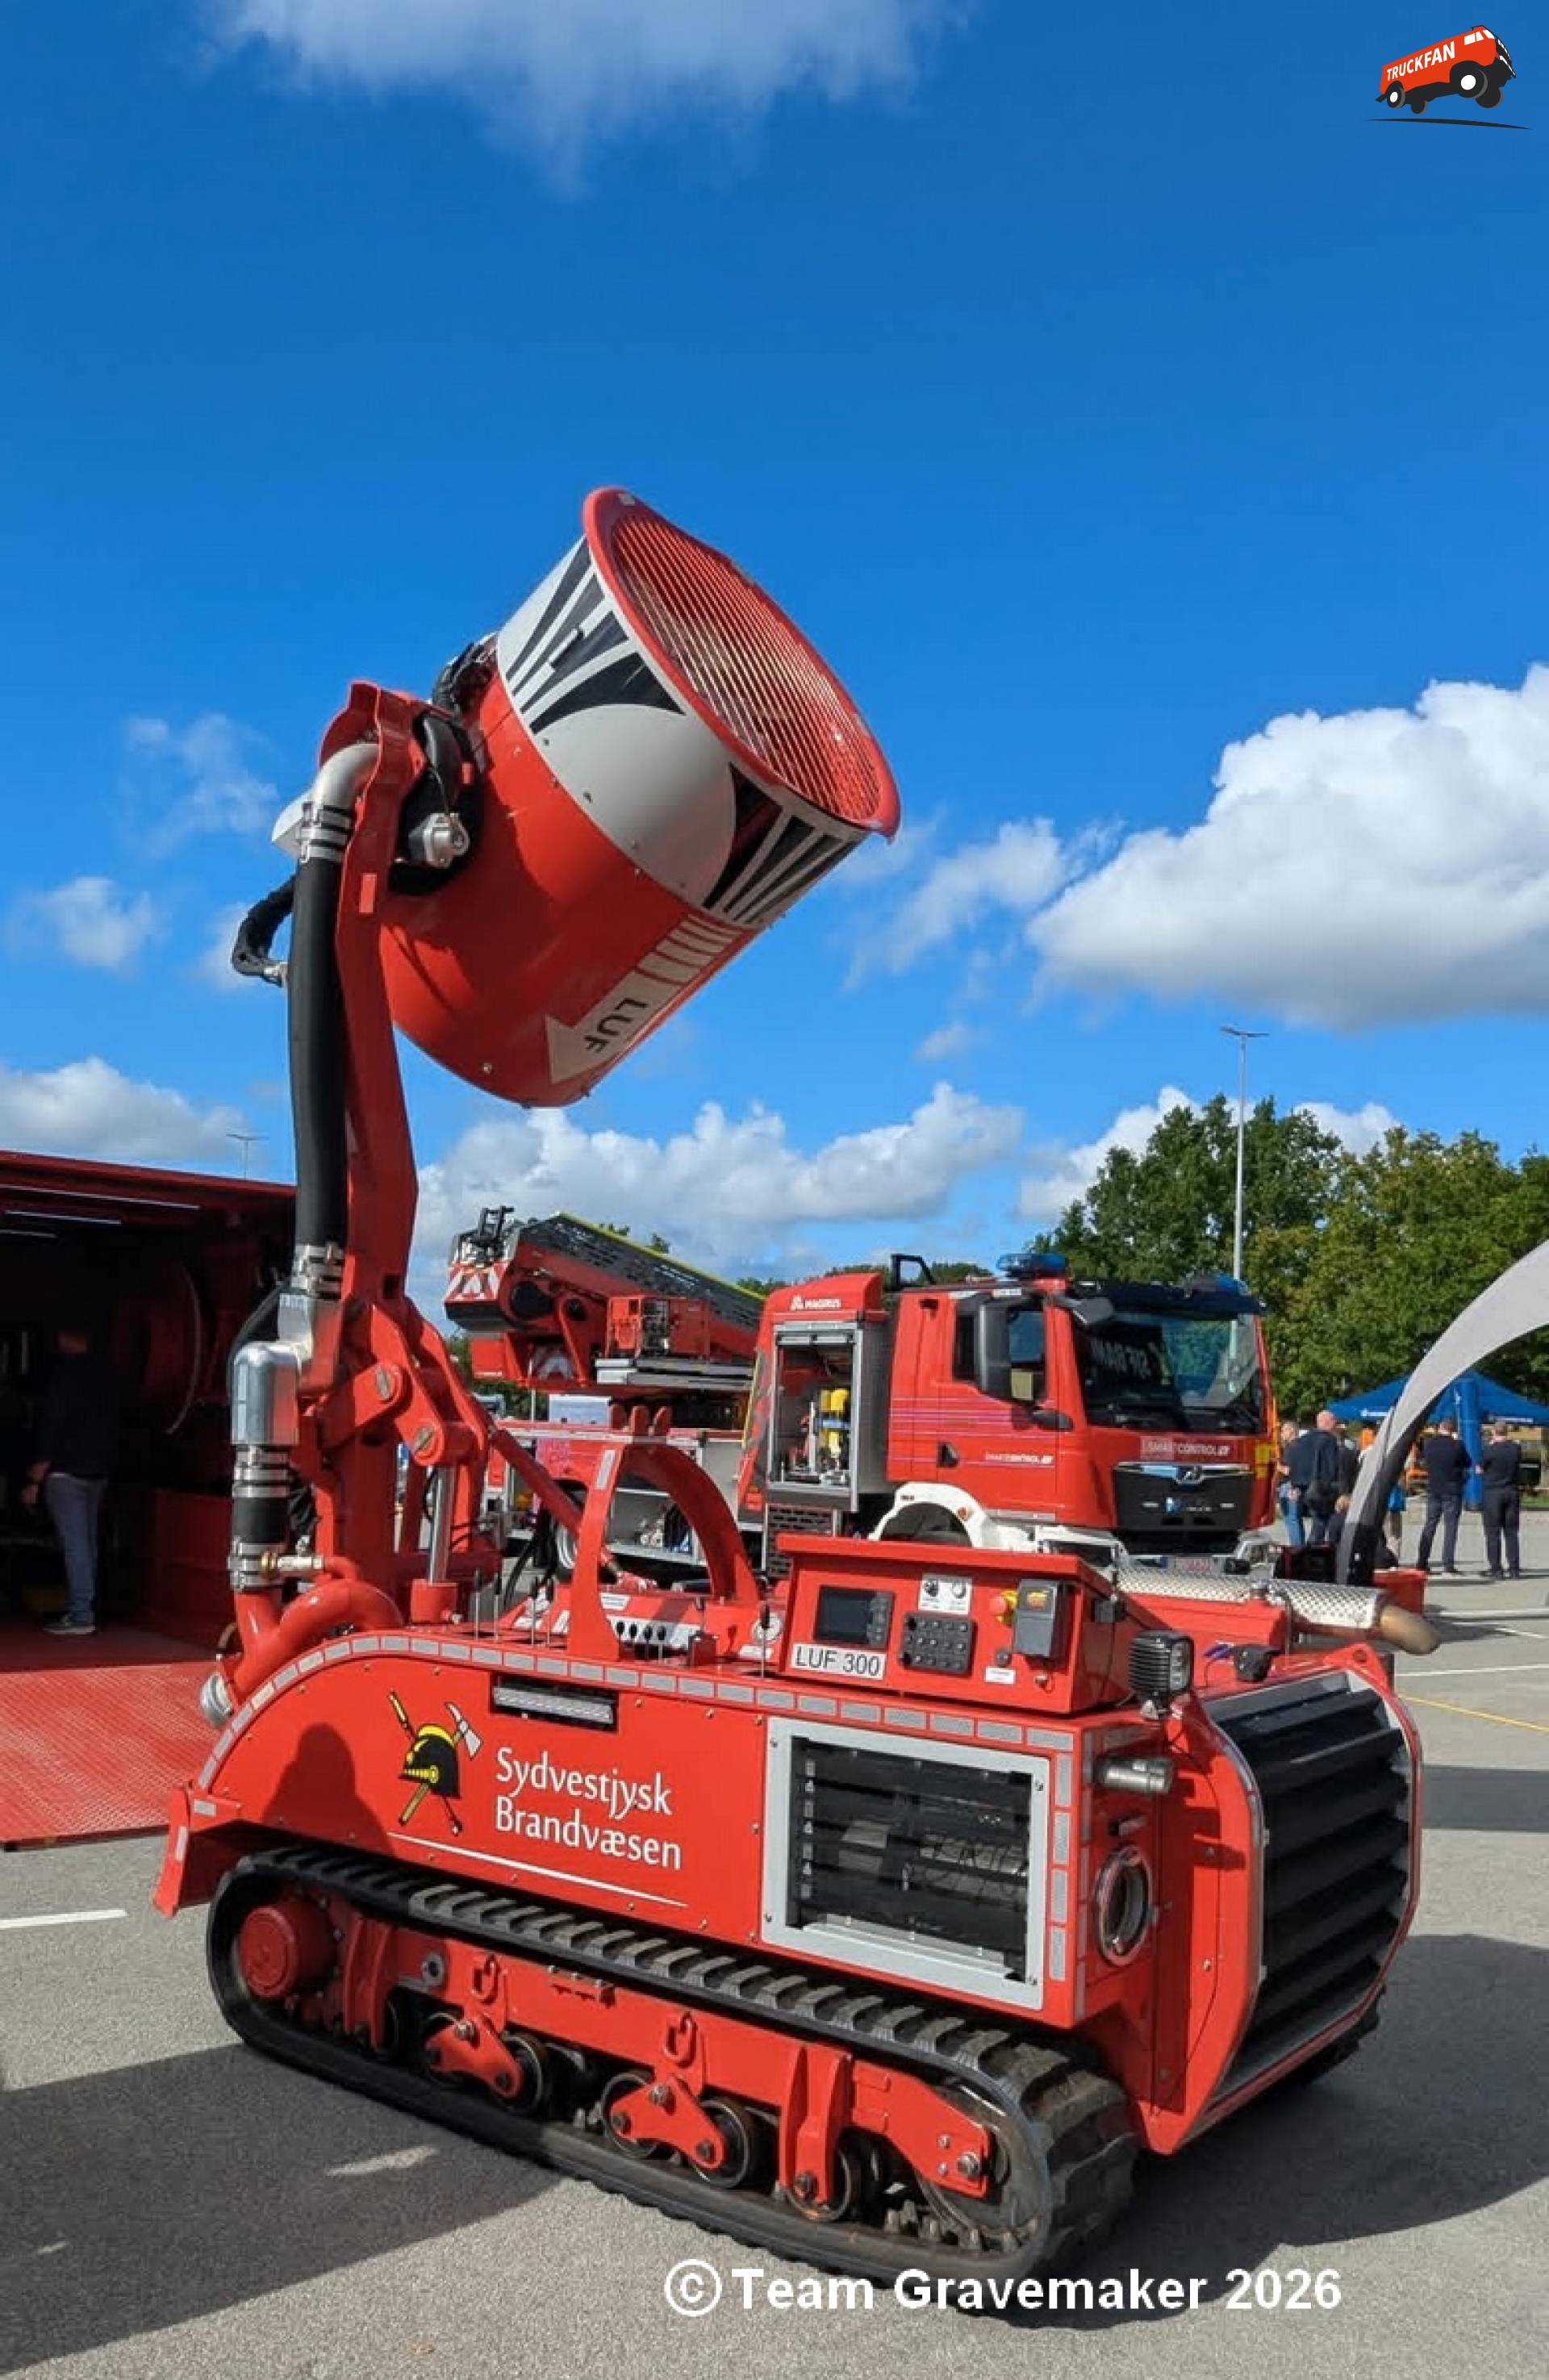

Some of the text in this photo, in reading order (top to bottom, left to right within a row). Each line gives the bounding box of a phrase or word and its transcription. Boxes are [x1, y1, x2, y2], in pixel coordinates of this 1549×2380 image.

[584, 996, 649, 1054] LUF
[795, 1645, 879, 1676] LUF 300
[496, 1746, 672, 1821] Sydvestjysk
[496, 1795, 682, 1871] Brandvæsen
